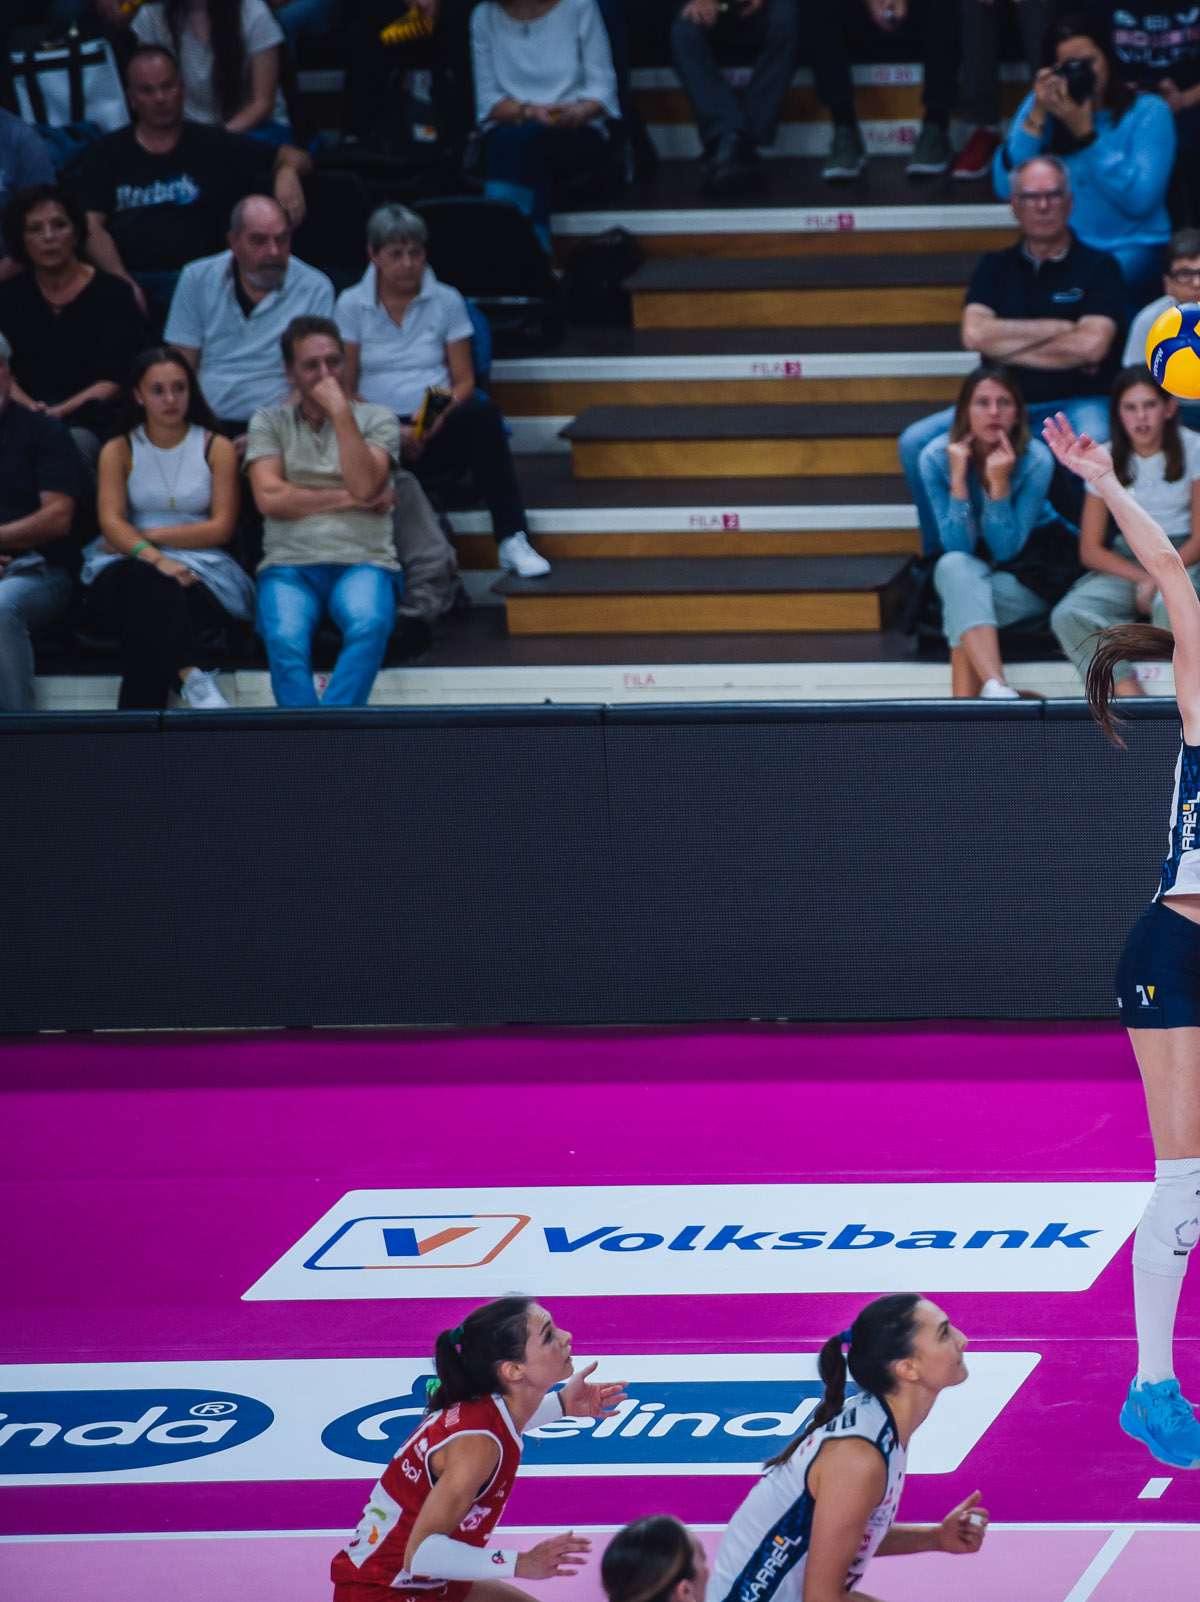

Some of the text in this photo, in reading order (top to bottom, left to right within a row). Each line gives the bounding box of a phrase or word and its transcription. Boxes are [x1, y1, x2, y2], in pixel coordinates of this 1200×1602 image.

[689, 515, 721, 528] FILA
[622, 671, 656, 687] FILA
[542, 1222, 1104, 1254] Volksbank
[0, 1406, 238, 1448] nda
